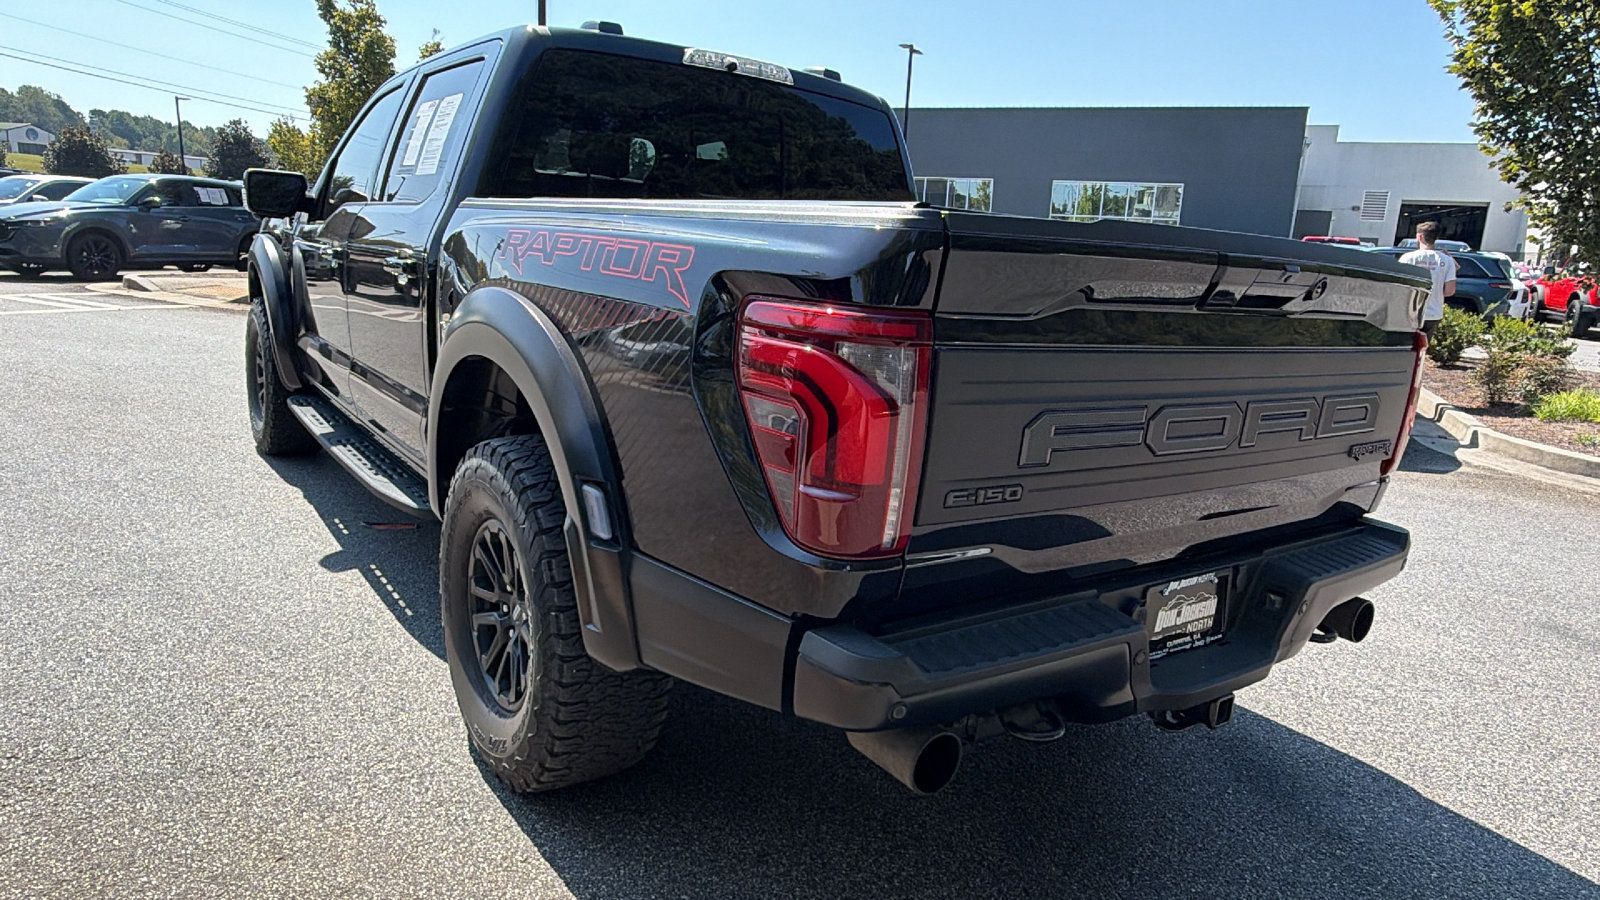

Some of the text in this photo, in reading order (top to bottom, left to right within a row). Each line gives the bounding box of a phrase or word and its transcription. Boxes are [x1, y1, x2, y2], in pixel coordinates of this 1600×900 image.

[500, 229, 695, 309] RAPTOR
[1018, 392, 1380, 468] FORD
[943, 483, 1024, 509] F-150
[1186, 616, 1214, 633] NORTH
